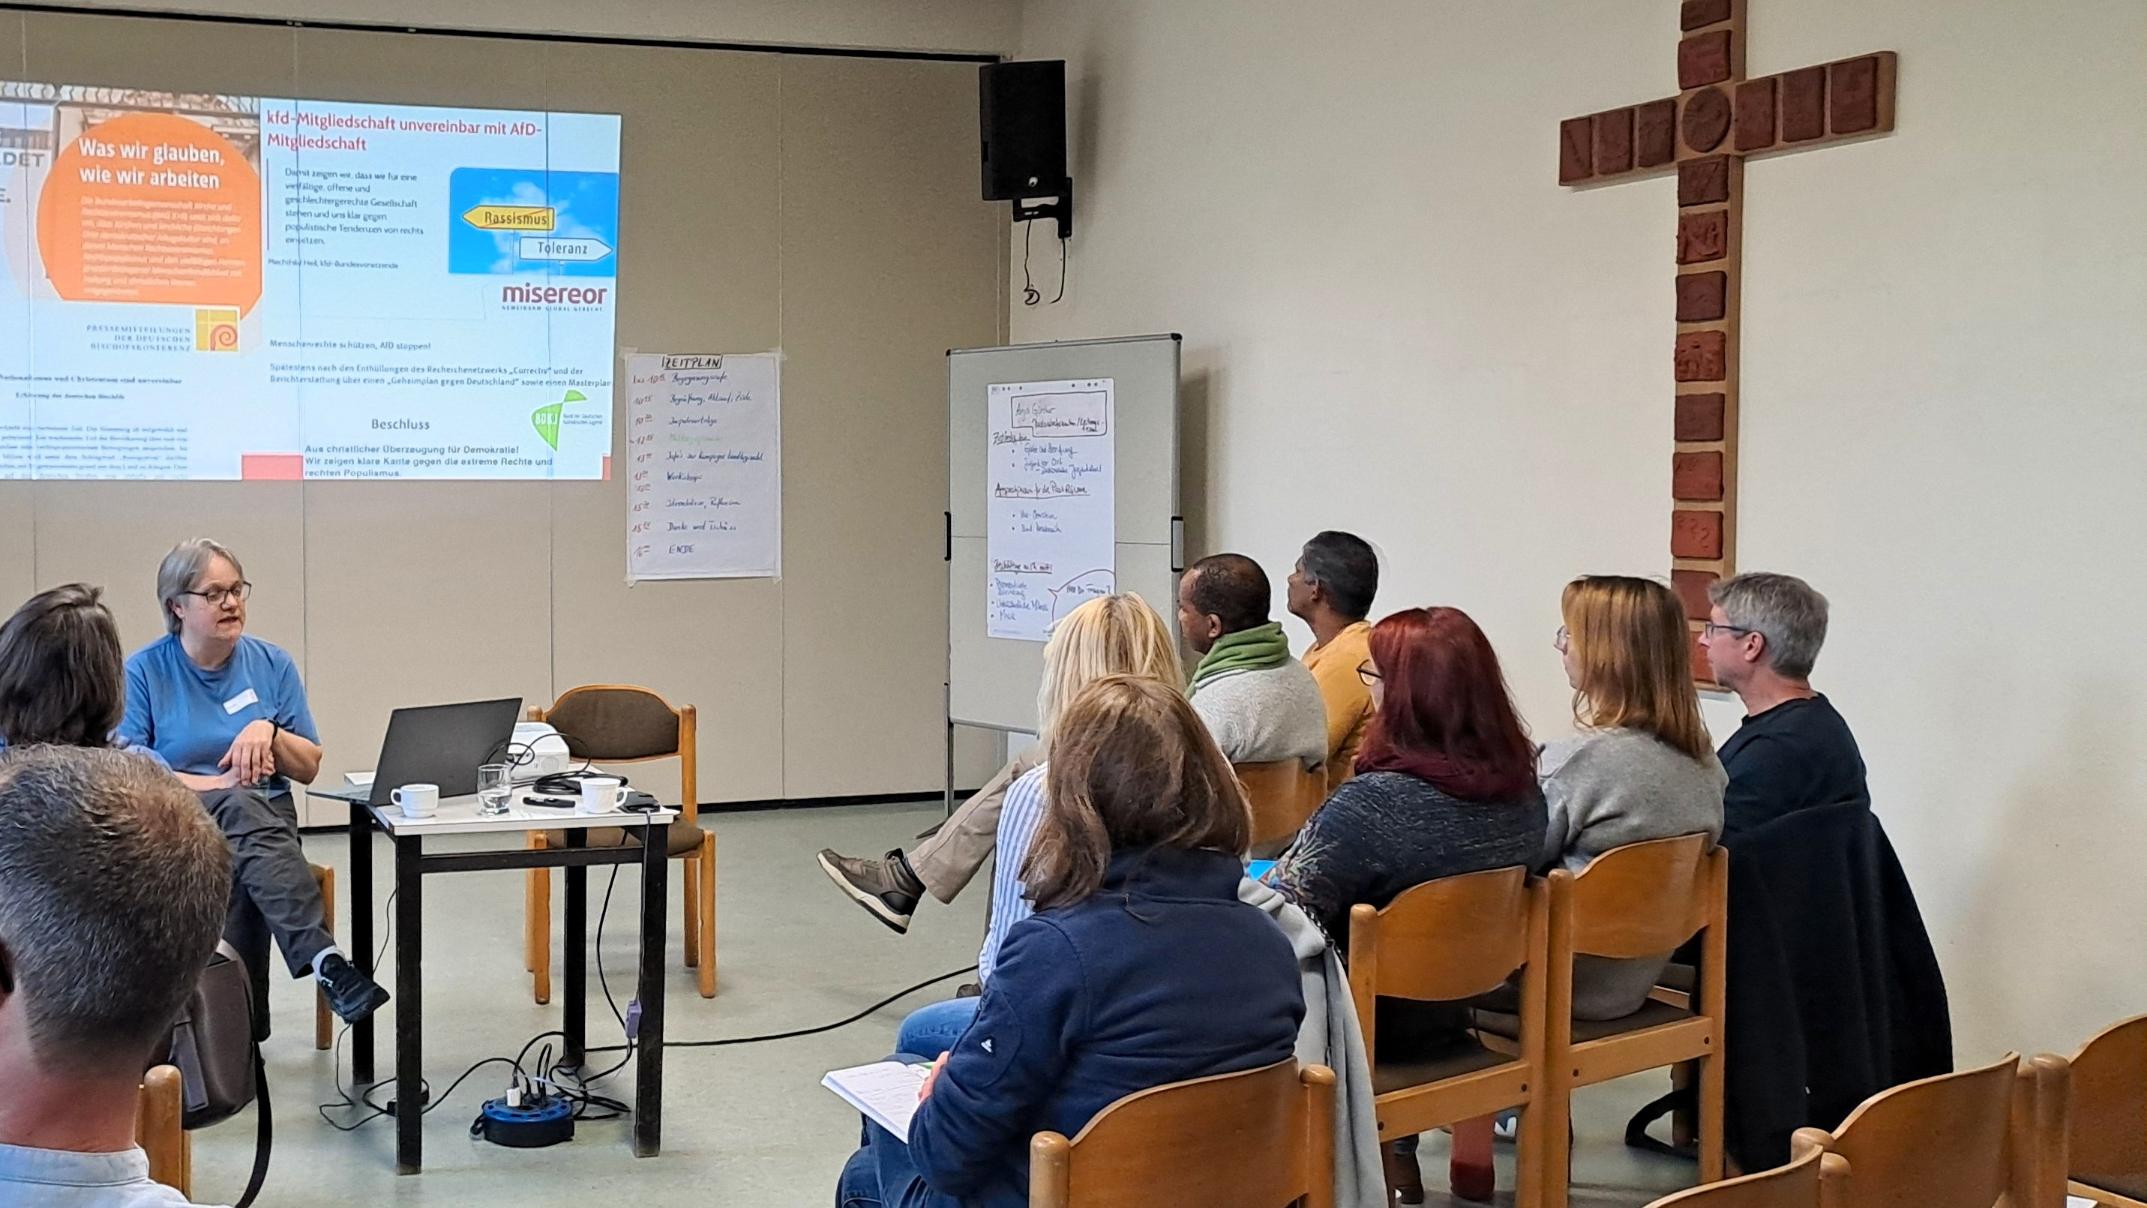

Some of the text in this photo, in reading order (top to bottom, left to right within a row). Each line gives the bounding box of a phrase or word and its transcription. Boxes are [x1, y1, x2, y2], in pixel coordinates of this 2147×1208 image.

[267, 110, 542, 136] kfd-Mitgliedschaft unvereinbar mit AfD-
[267, 133, 367, 151] Mitgliedschaft
[78, 137, 226, 167] Was wir glauben,
[80, 165, 221, 190] wie wir arbeiten
[355, 171, 372, 180] dass
[327, 183, 353, 193] offene
[354, 184, 371, 193] und
[370, 198, 417, 208] Gesellschaft
[314, 210, 330, 218] und
[331, 211, 346, 219] uns
[363, 212, 387, 222] gegen
[484, 210, 548, 227] Rassismus
[339, 223, 382, 233] Tendenzen
[384, 226, 399, 234] von
[400, 226, 424, 235] rechts
[537, 240, 588, 255] Toleranz
[502, 282, 608, 305] misereor
[114, 334, 132, 342] DER
[317, 363, 338, 372] nach
[338, 363, 355, 372] den
[410, 365, 425, 374] des
[553, 367, 569, 375] und
[570, 367, 584, 375] der
[665, 357, 721, 369] ZEITPLAN
[521, 378, 544, 386] sowie
[371, 418, 430, 430] Beschluss
[305, 445, 324, 453] Aus
[326, 445, 380, 453] christlicher
[382, 445, 445, 455] Überzeugung
[447, 445, 461, 454] für
[304, 457, 553, 468] Wir zeigen klare Kante gegen die extreme Rechte und
[304, 469, 341, 477] rechten
